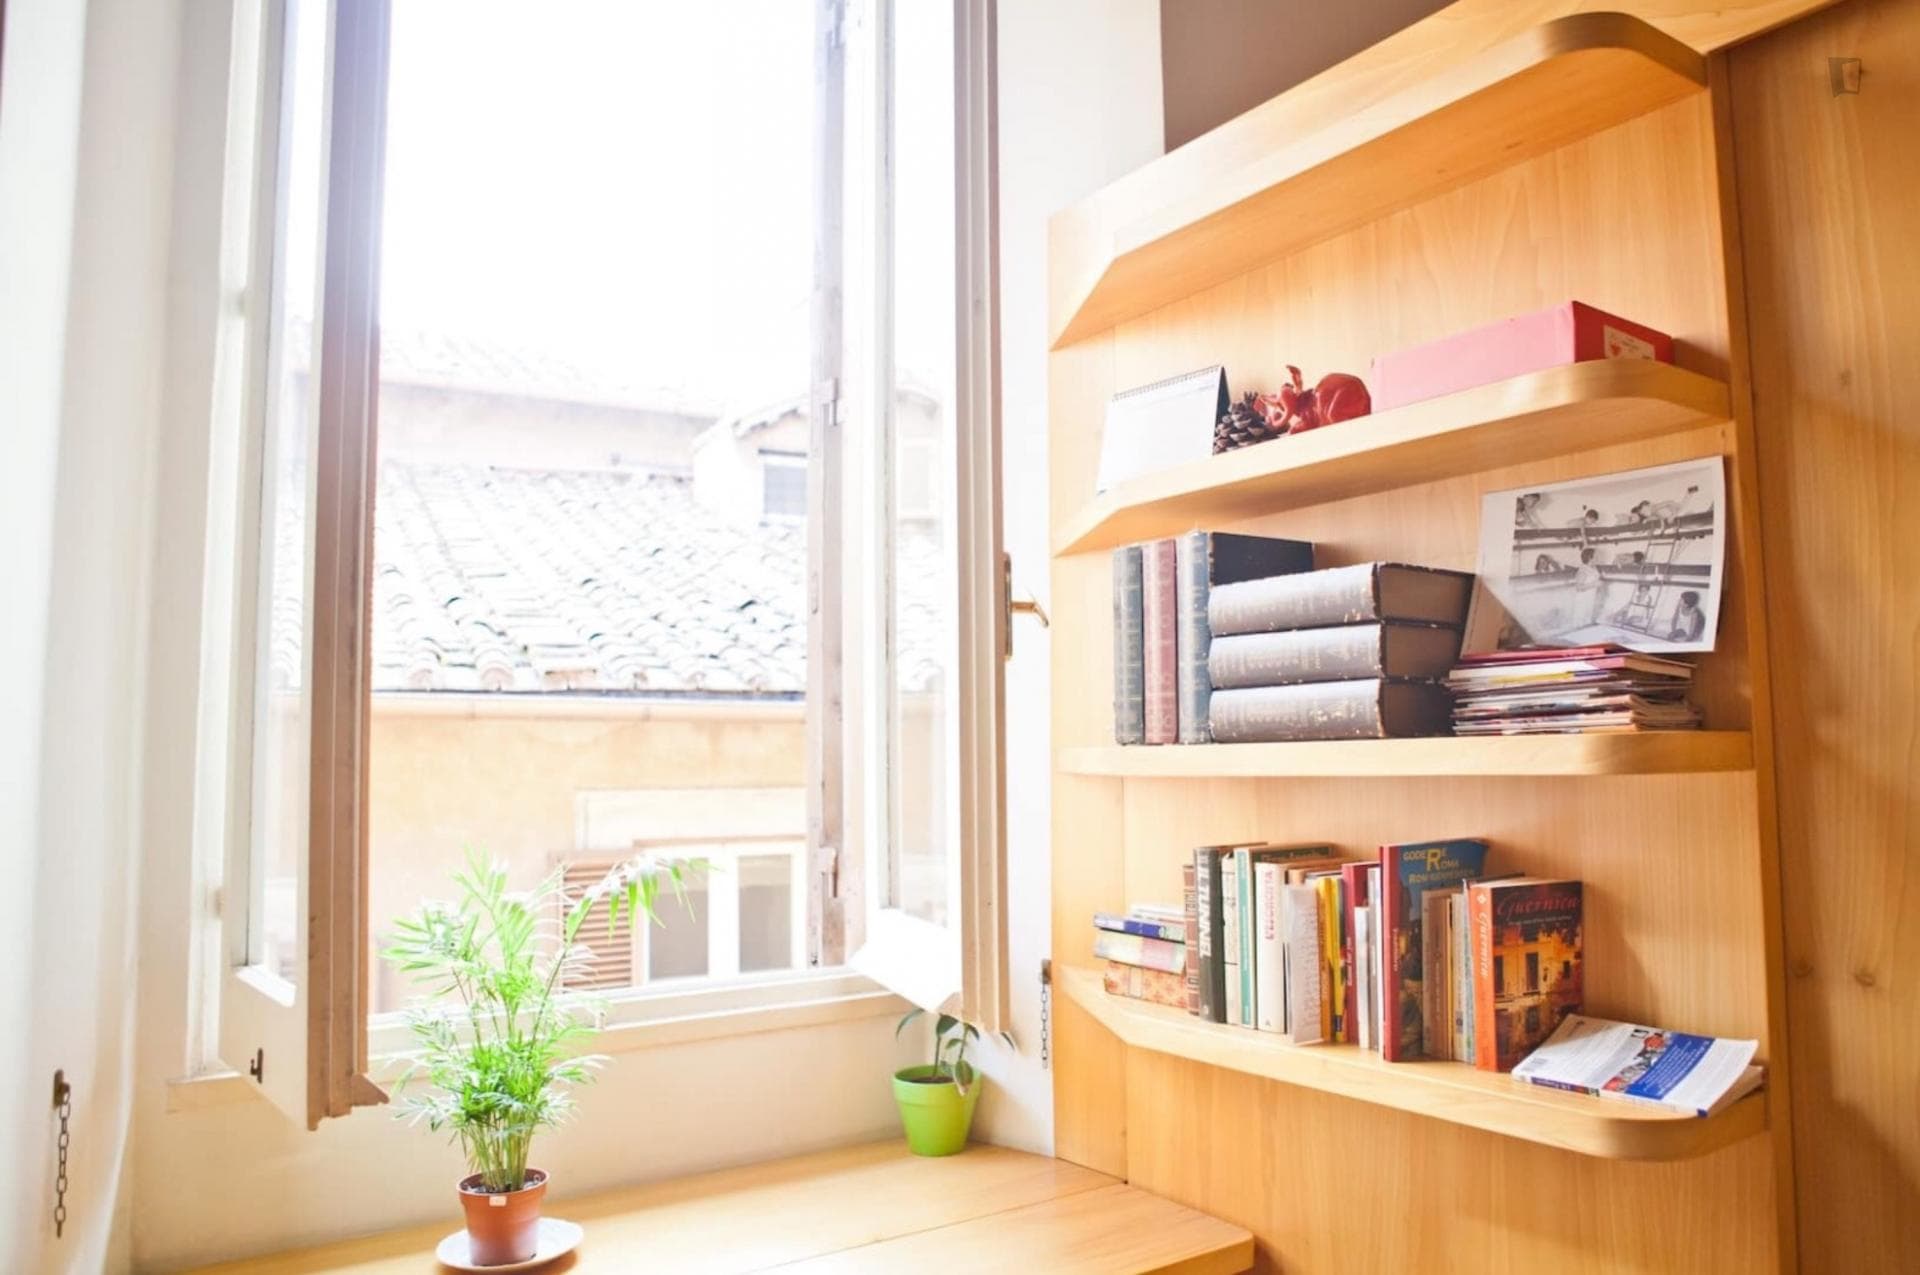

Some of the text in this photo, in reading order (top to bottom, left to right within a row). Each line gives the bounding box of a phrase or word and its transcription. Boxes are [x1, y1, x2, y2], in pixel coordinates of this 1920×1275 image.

[1198, 884, 1212, 959] TUNNEL
[1496, 892, 1579, 921] Guernica
[1477, 911, 1490, 977] Guernica
